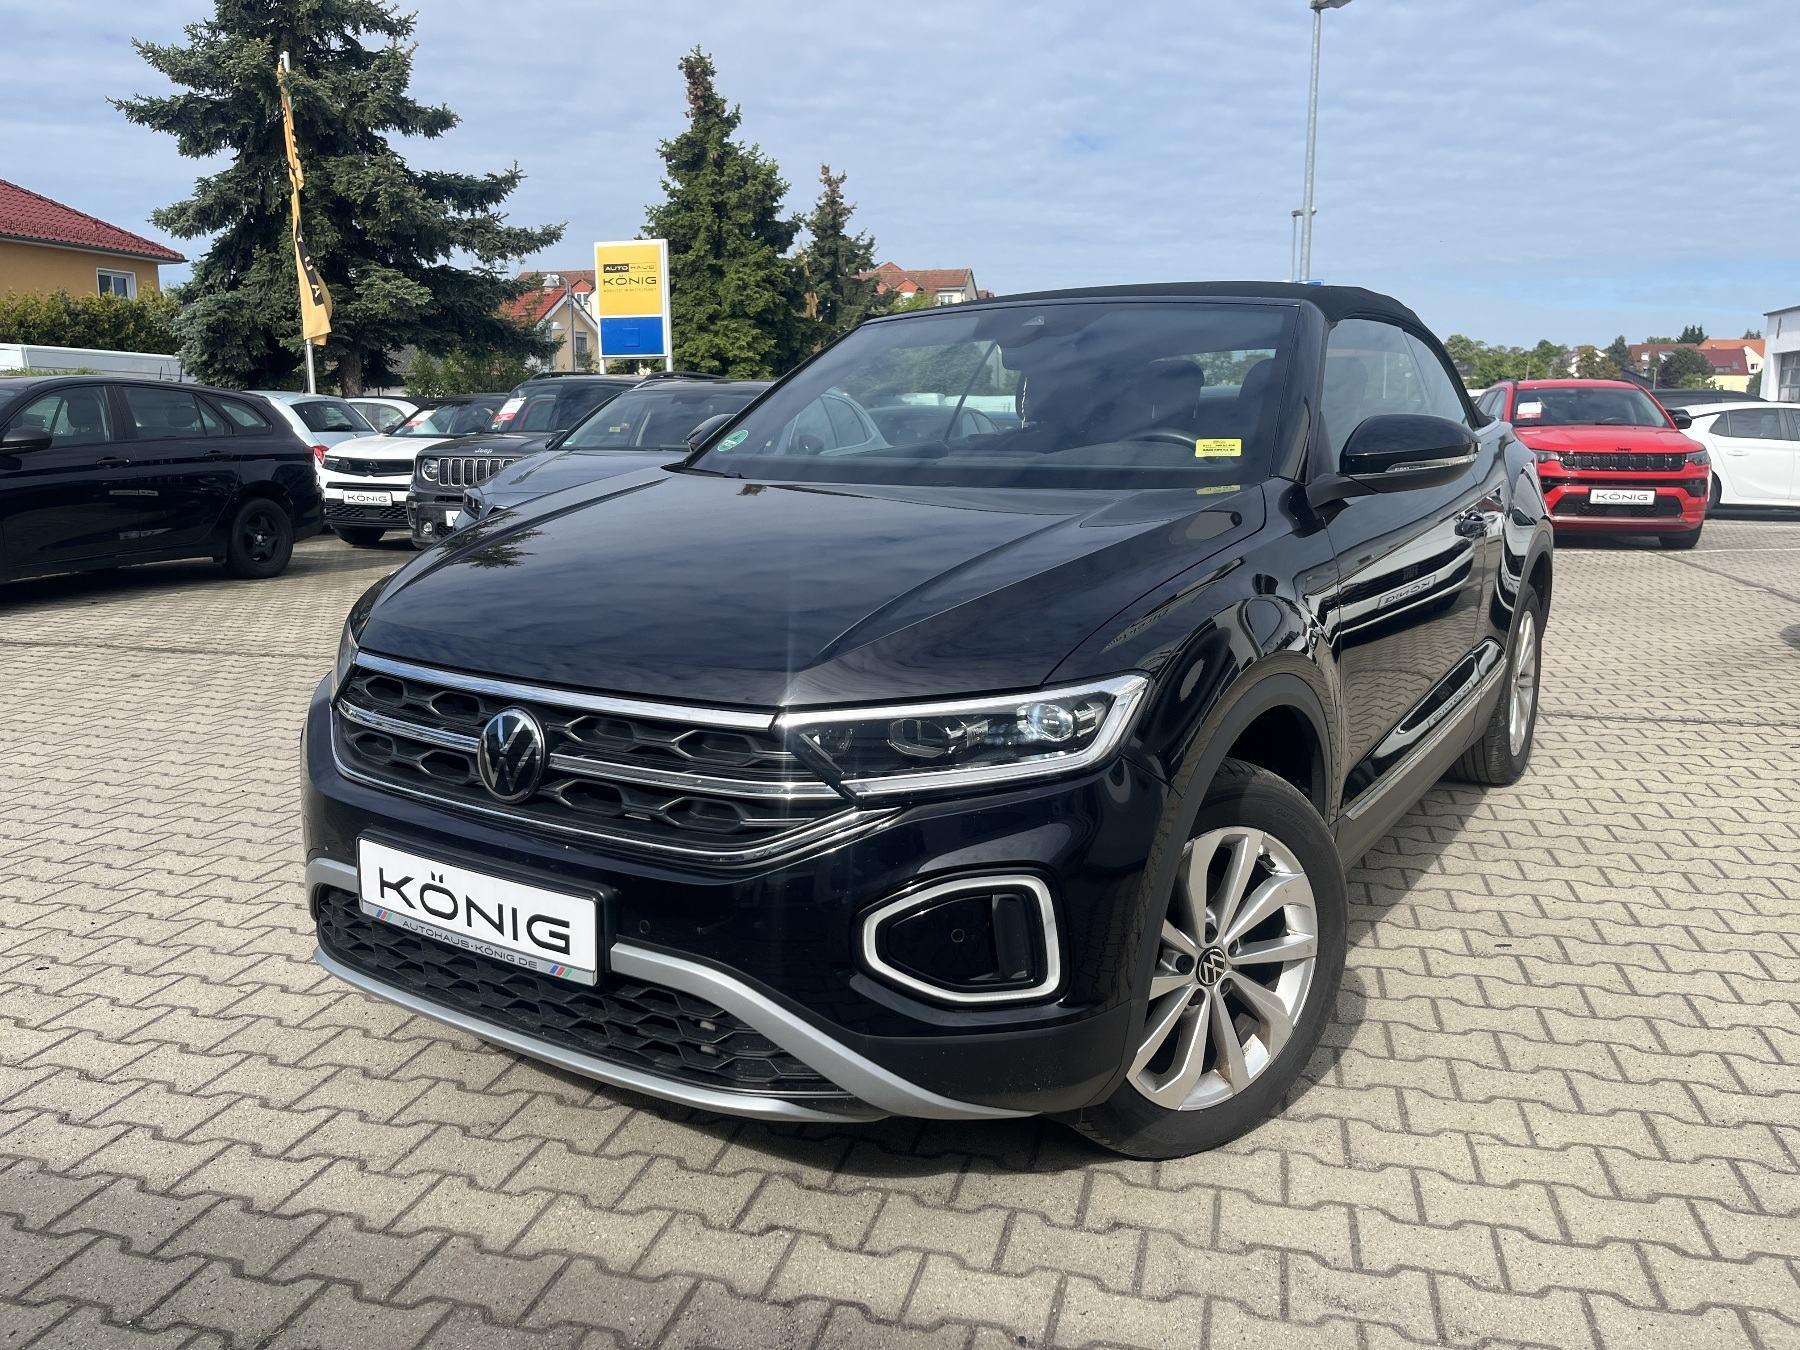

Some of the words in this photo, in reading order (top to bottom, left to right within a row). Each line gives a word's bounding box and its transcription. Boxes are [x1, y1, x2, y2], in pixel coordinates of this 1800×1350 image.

[605, 264, 629, 272] AUTO
[603, 274, 657, 286] KÖNIG
[474, 447, 493, 455] Jeep
[347, 492, 388, 503] KÖNIG
[1596, 492, 1649, 501] KÖNIG
[378, 867, 571, 956] KÖNIG
